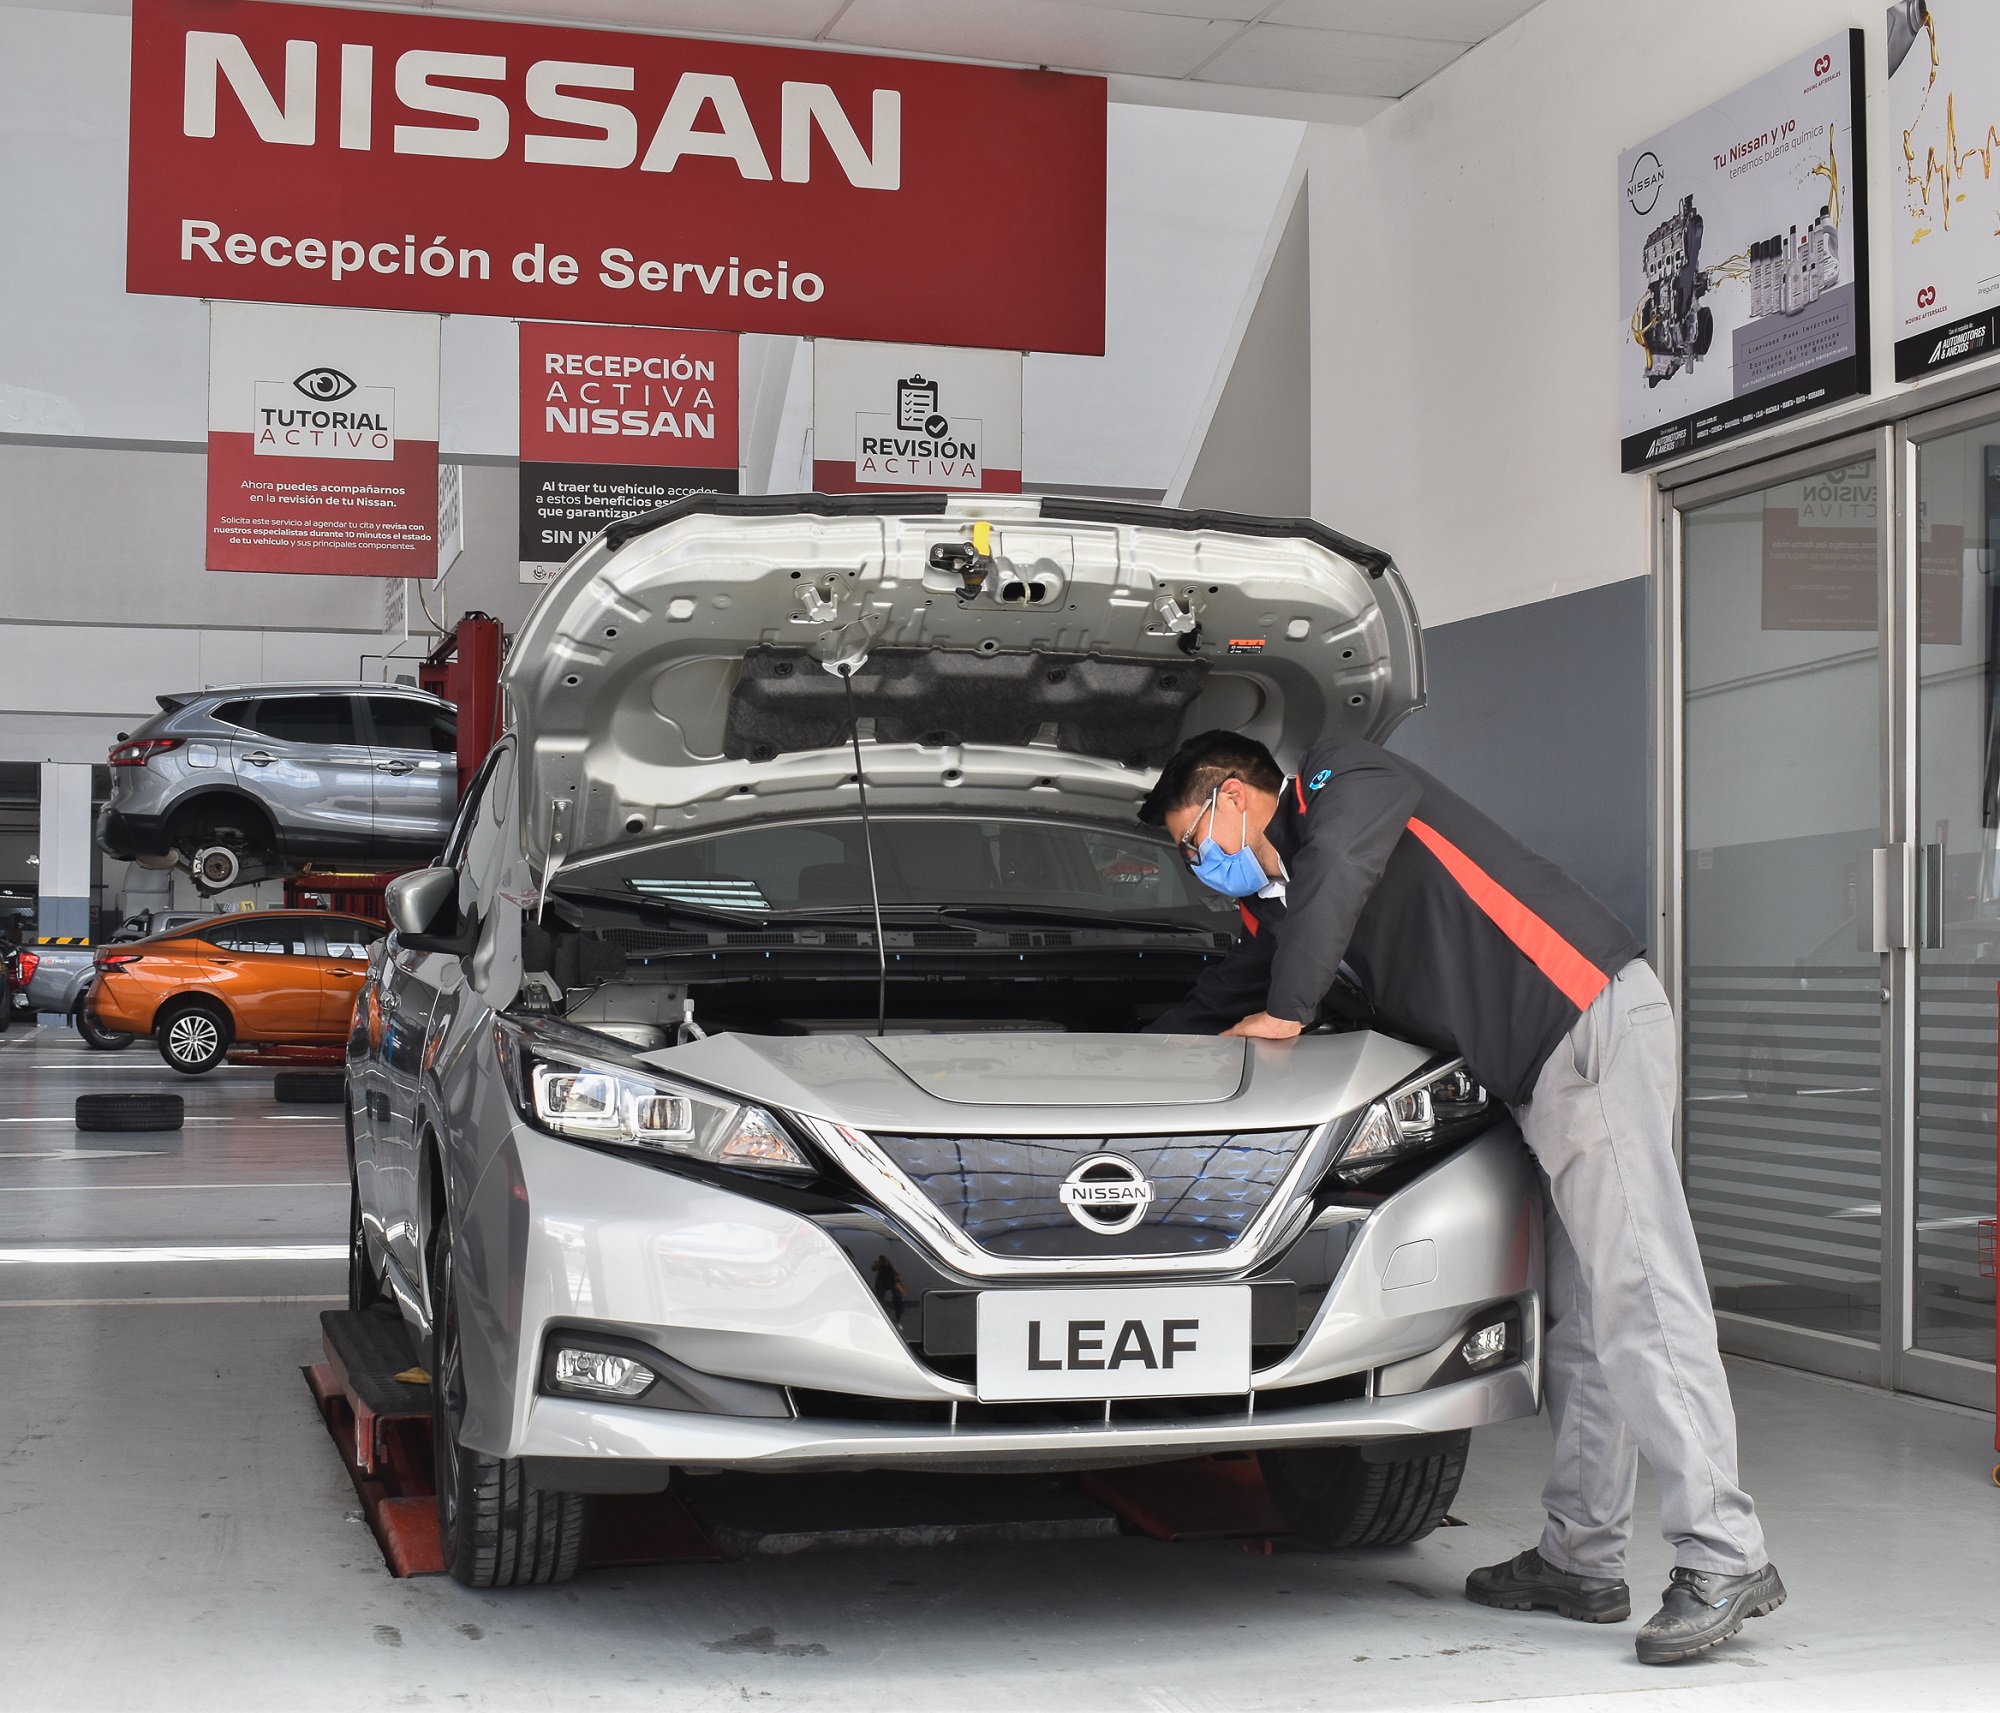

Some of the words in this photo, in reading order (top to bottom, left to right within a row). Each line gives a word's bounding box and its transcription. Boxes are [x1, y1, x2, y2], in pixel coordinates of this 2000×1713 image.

[183, 29, 901, 191] NISSAN
[1714, 154, 1726, 170] Tu
[1729, 133, 1768, 162] Nissan
[1771, 128, 1778, 145] y
[1780, 119, 1796, 140] yo
[1729, 154, 1763, 179] tenemos
[1764, 142, 1790, 162] buena
[1791, 125, 1824, 149] química
[1626, 170, 1664, 198] NISSAN
[180, 218, 491, 282] Recepción
[511, 243, 579, 286] de
[599, 247, 825, 302] Servicio
[1922, 305, 1948, 319] AFTERSALES
[1942, 326, 1986, 349] AUTOMOTORES
[1940, 349, 1946, 359] &
[1946, 342, 1969, 358] ANEXOS
[545, 354, 714, 382] RECEPCIÓN
[546, 380, 714, 409] ACTIVA
[260, 408, 388, 431] TUTORIAL
[545, 406, 714, 439] NISSAN
[260, 428, 389, 449] ACTIVO
[862, 437, 976, 460] REVISIÓN
[862, 458, 976, 478] ACTIVA
[240, 480, 274, 490] Ahora
[276, 482, 318, 493] puedes
[320, 484, 406, 495] acompañarnos
[542, 481, 555, 492] Al
[558, 482, 590, 493] traer
[593, 484, 607, 493] tu
[610, 484, 665, 495] vehículo
[250, 494, 264, 503] en
[267, 494, 276, 503] la
[278, 495, 323, 505] revisión
[325, 496, 339, 506] de
[342, 498, 354, 506] tu
[356, 497, 397, 508] Nissan.
[536, 496, 543, 504] a
[546, 495, 581, 505] estos
[584, 495, 652, 507] beneficios
[221, 516, 250, 525] Solicita
[271, 518, 302, 527] servicio
[313, 520, 347, 529] agendar
[359, 521, 374, 529] cita
[538, 508, 563, 518] que
[566, 508, 637, 519] garantizan
[253, 527, 308, 537] especialistas
[310, 529, 344, 538] durante
[356, 531, 392, 540] minutos
[402, 533, 432, 541] estado
[253, 537, 289, 546] vehículo
[313, 540, 356, 549] principales
[358, 541, 416, 550] componentes.
[541, 530, 573, 544] SIN
[1072, 1187, 1147, 1200] NISSAN
[1028, 1319, 1199, 1370] LEAF
